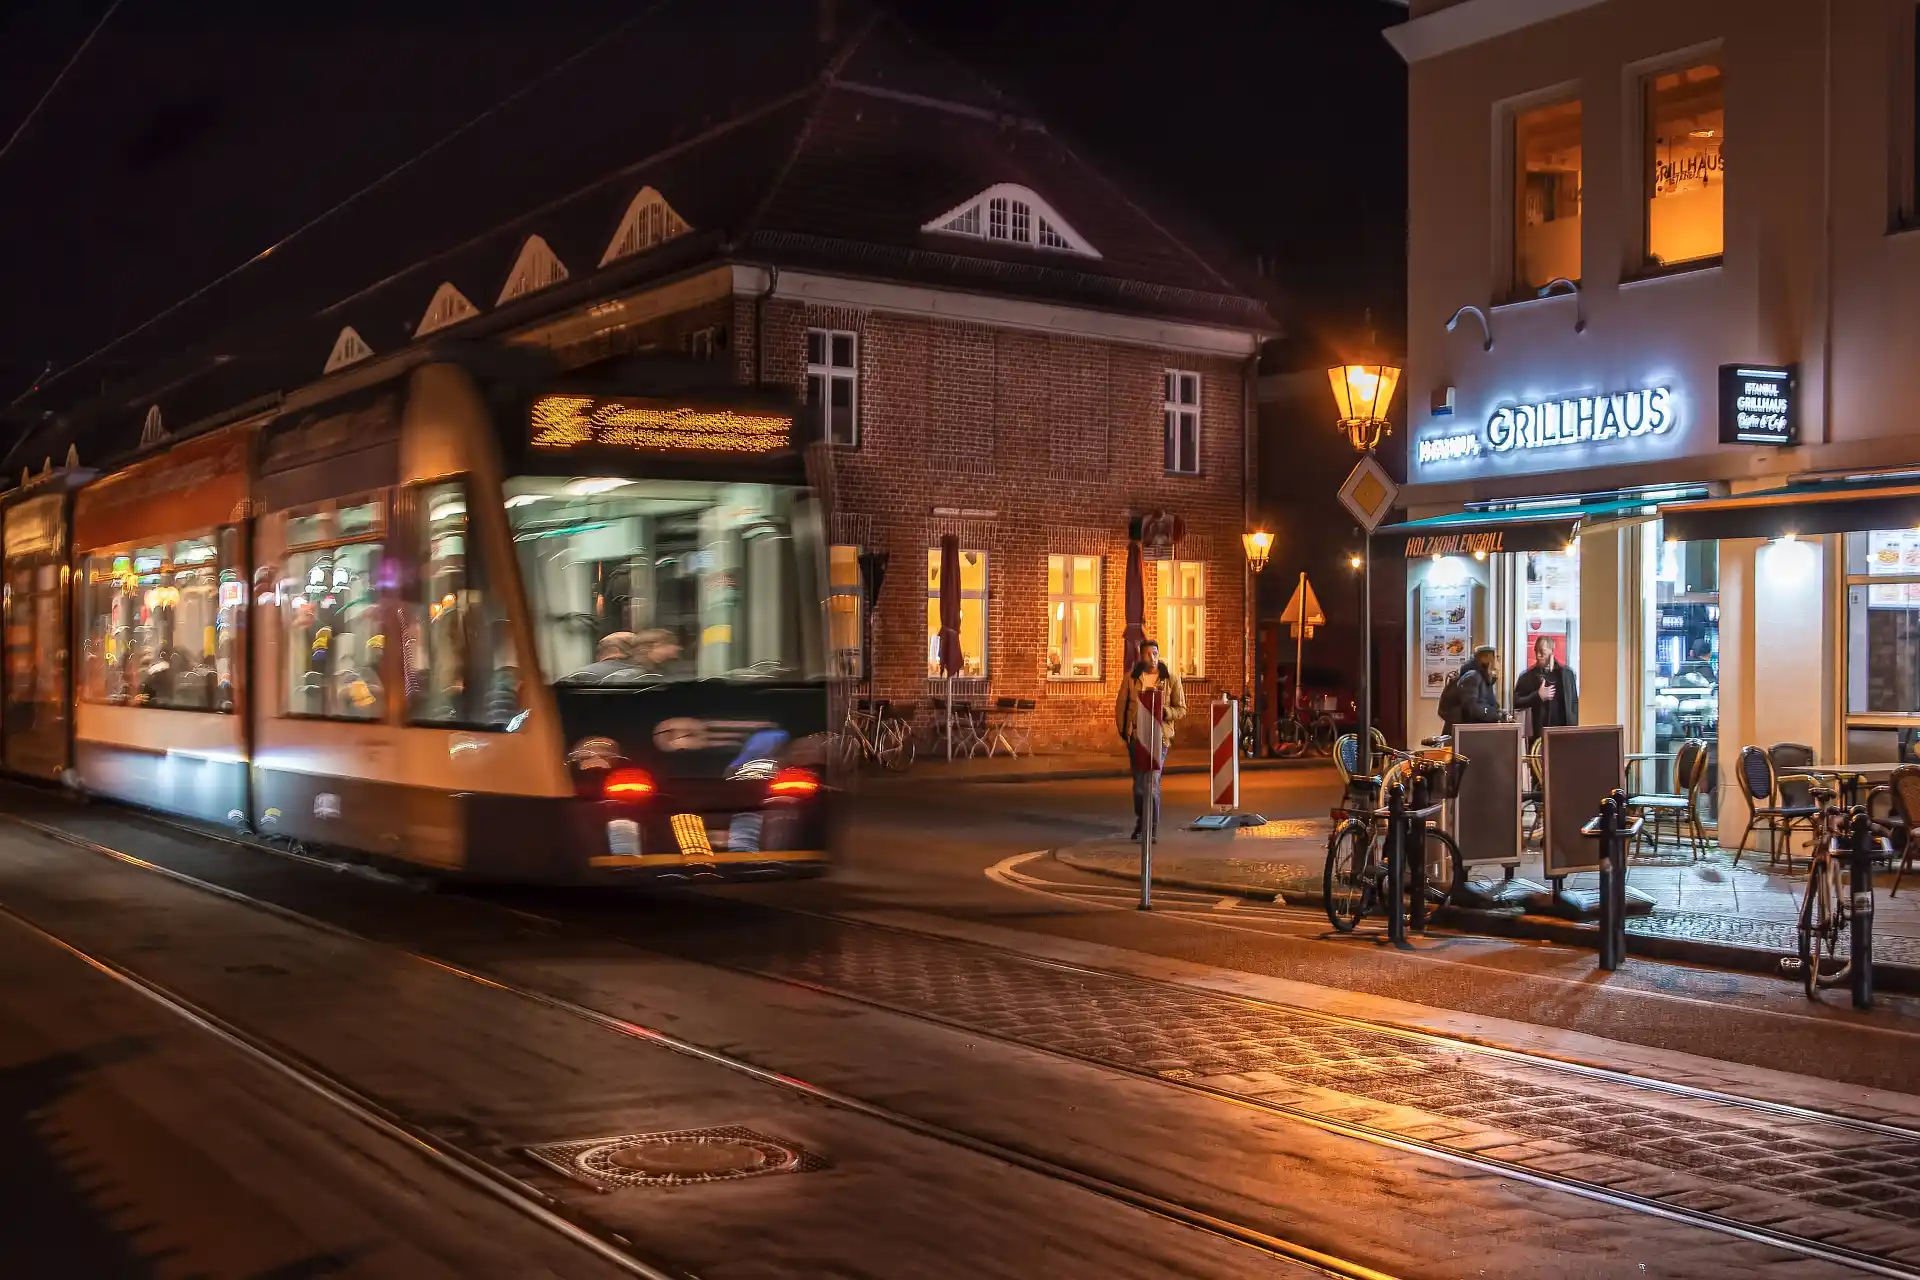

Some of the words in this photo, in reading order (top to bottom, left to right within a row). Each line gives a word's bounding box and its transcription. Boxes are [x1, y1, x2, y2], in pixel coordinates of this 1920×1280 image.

[1737, 396, 1788, 413] GRILLHAUS
[1486, 387, 1671, 451] GRILLHAUS
[1405, 531, 1504, 558] HOLZKOHLENGRILL
